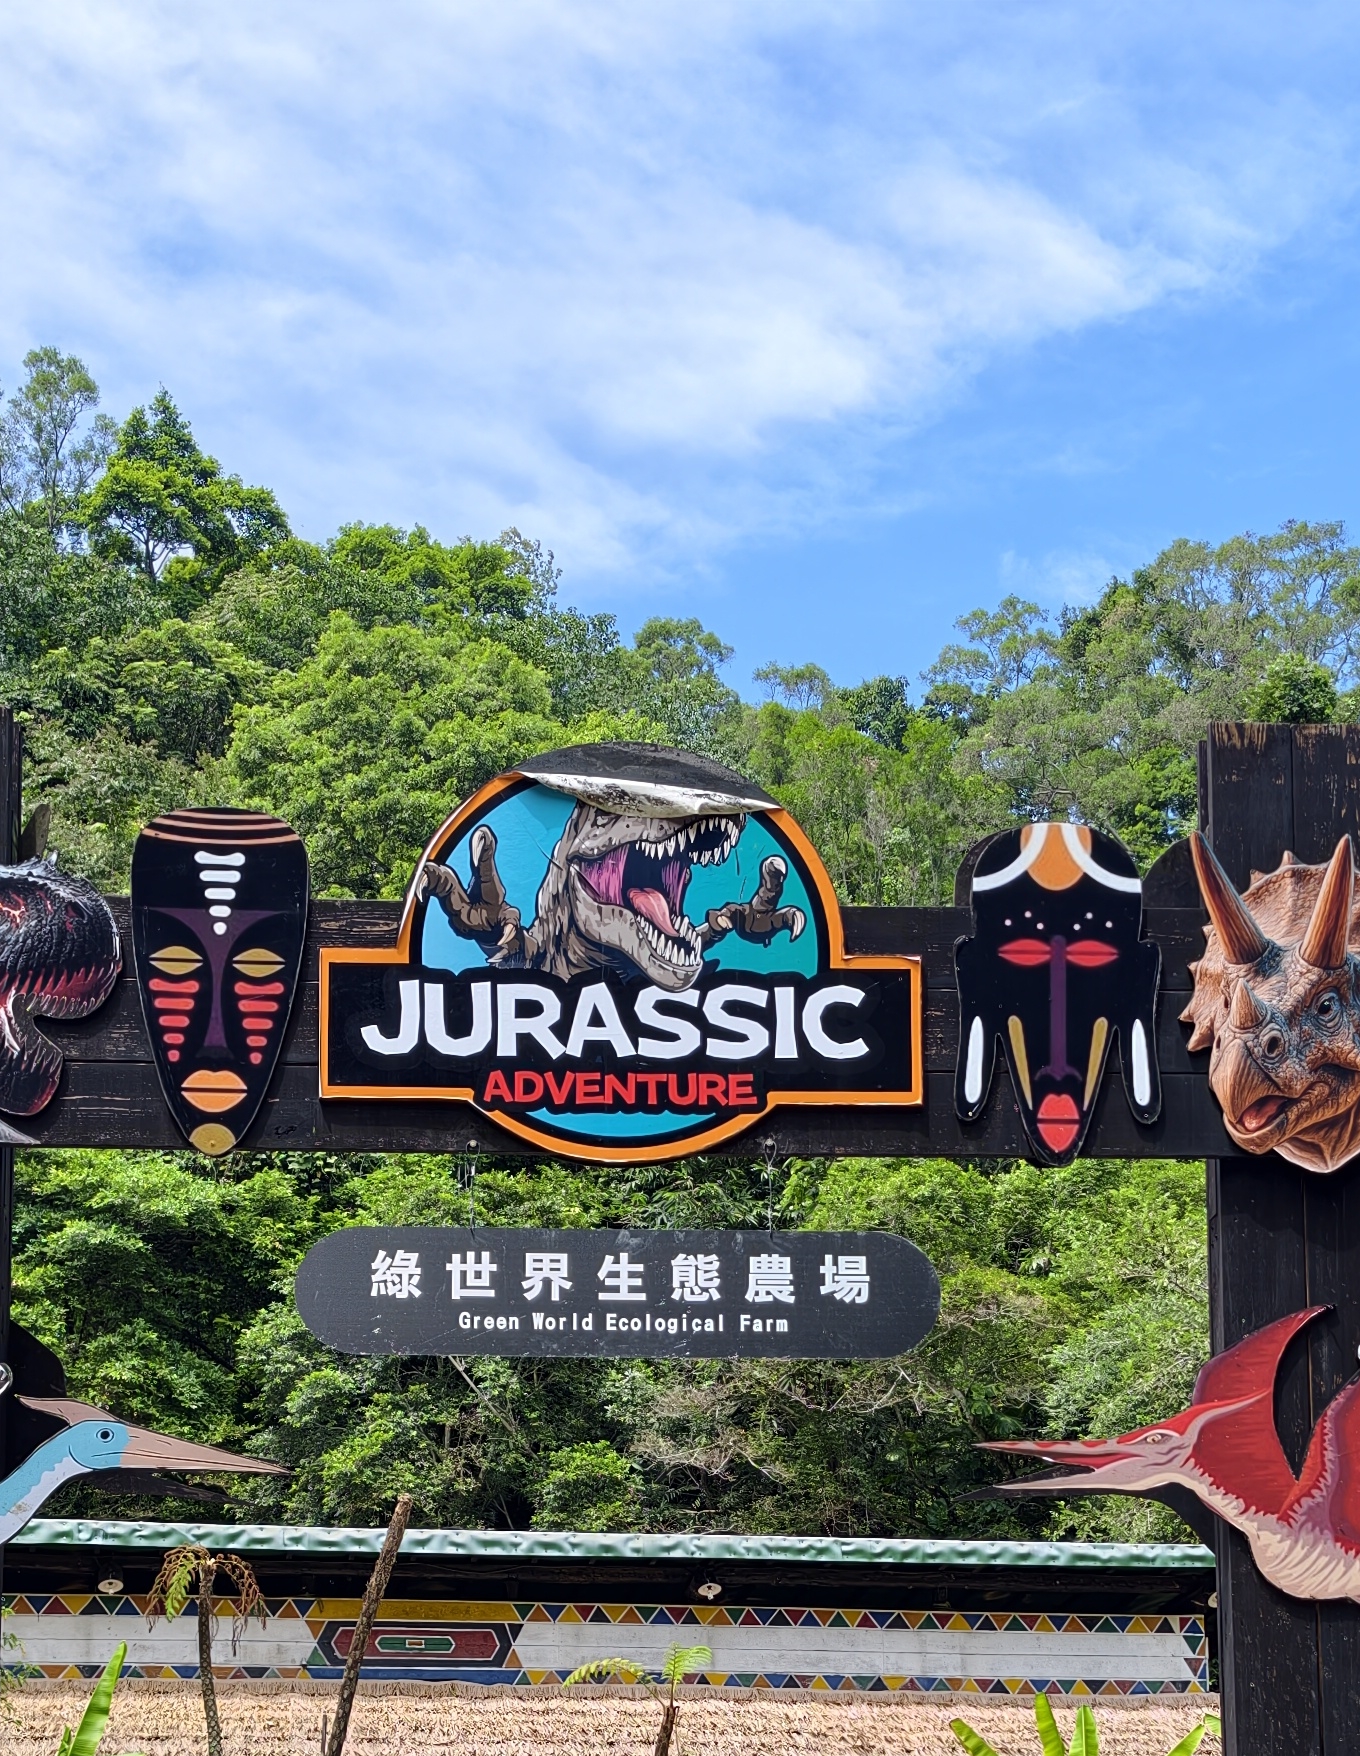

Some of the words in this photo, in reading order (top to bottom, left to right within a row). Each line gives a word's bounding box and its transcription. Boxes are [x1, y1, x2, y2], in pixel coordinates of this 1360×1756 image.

[360, 979, 870, 1060] JURASSIC
[483, 1070, 758, 1106] ADVENTURE
[370, 1249, 871, 1304] 綠世界生態農場
[458, 1311, 520, 1330] Green
[531, 1312, 593, 1331] World
[605, 1312, 724, 1335] Ecological
[739, 1314, 789, 1333] Farm
